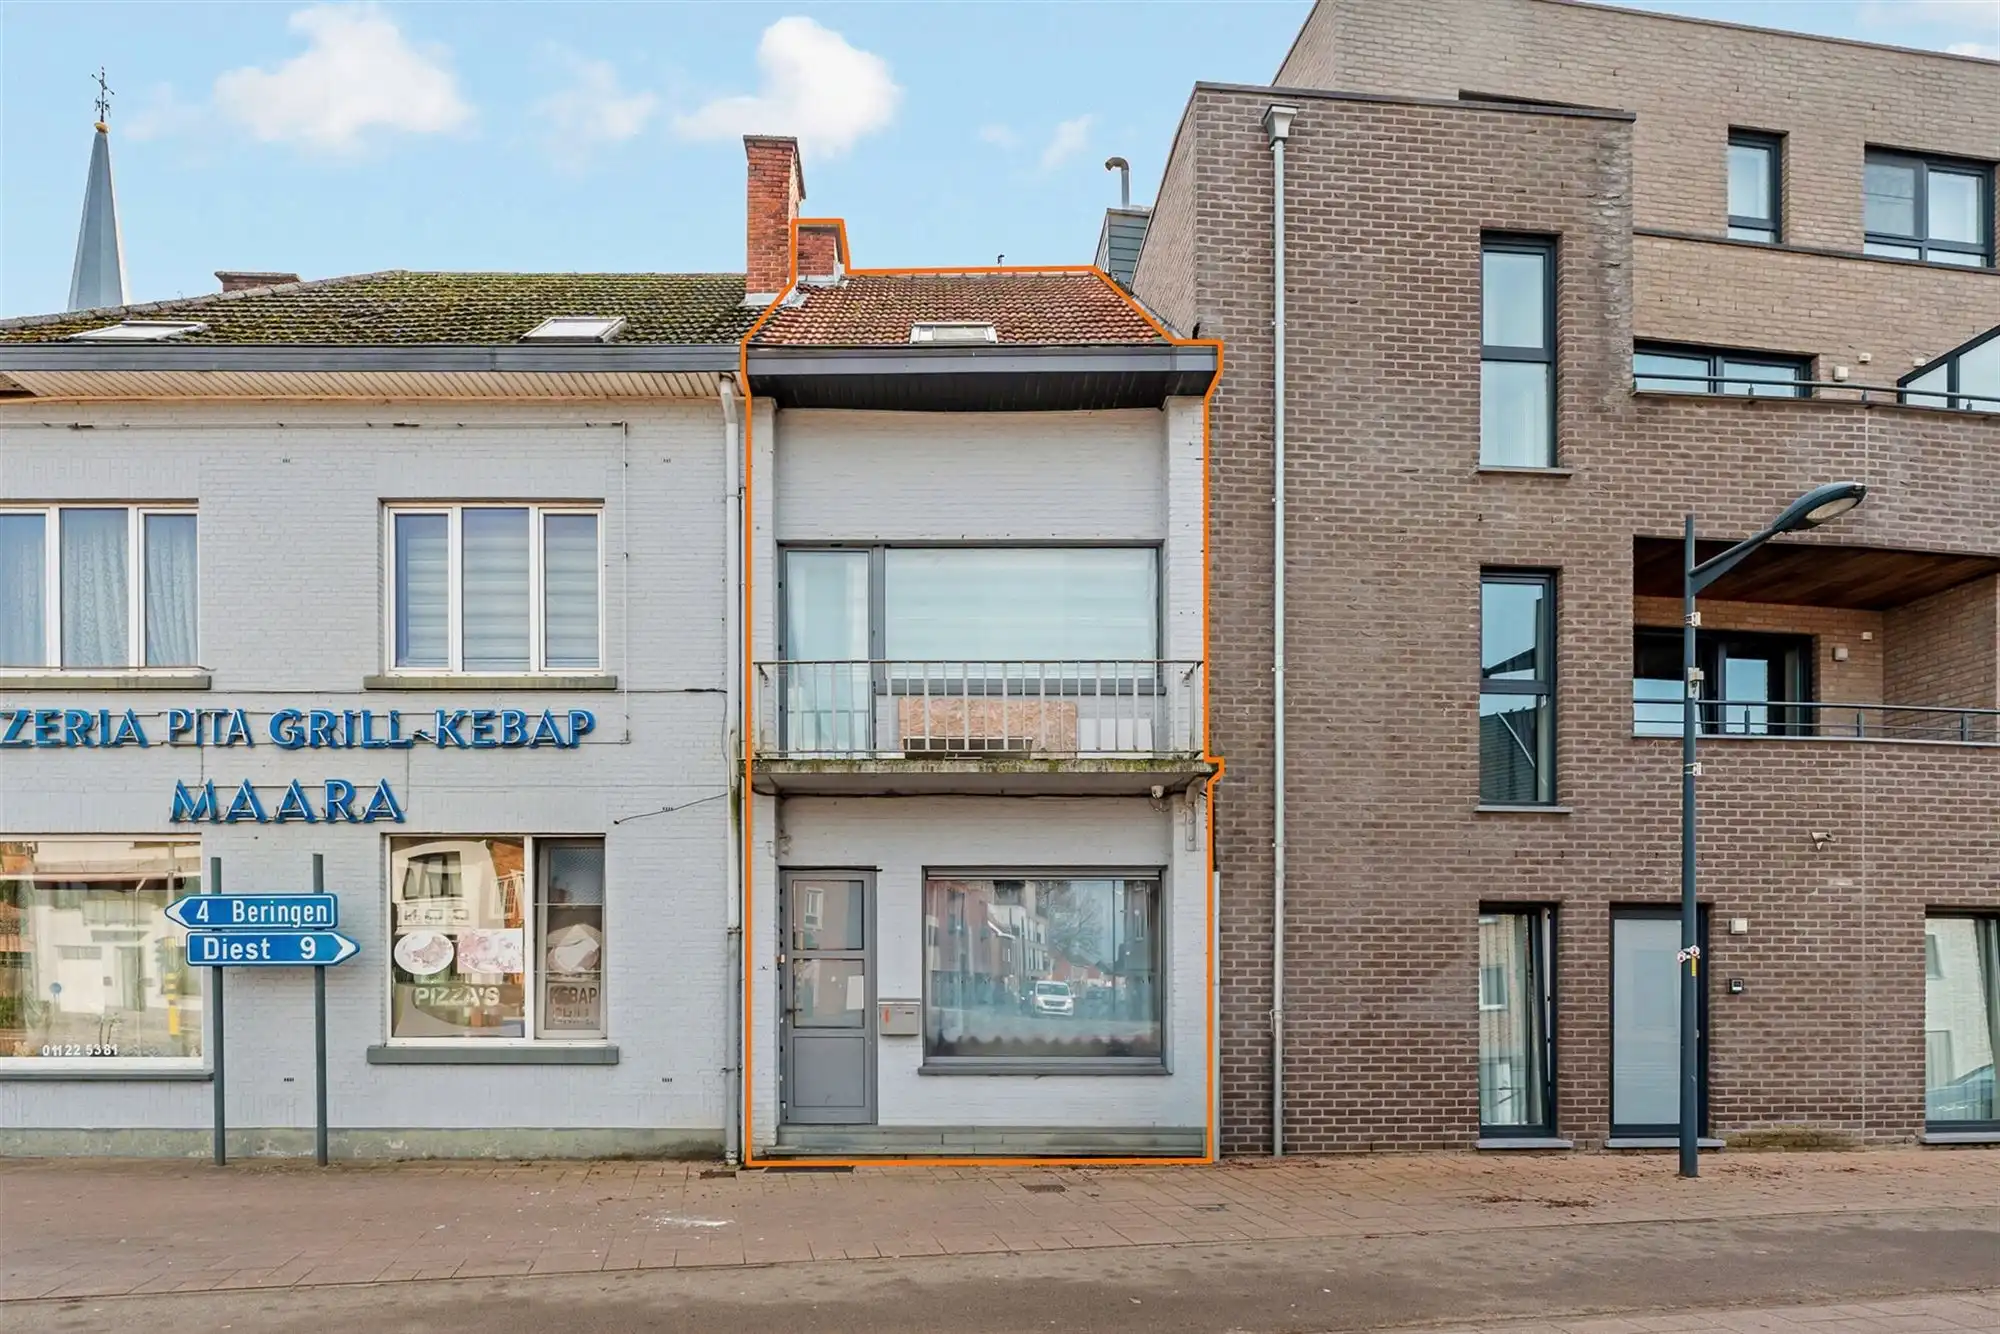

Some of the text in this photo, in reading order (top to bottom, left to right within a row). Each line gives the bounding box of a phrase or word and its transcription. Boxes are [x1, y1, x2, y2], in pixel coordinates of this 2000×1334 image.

[168, 708, 254, 748] PITA
[268, 708, 415, 750] GRILL
[434, 708, 597, 749] KEBAP
[169, 778, 408, 824] MAARA
[196, 900, 327, 928] 4 Beringen
[203, 936, 316, 960] Diest 9
[416, 986, 500, 1006] PIZZA'S
